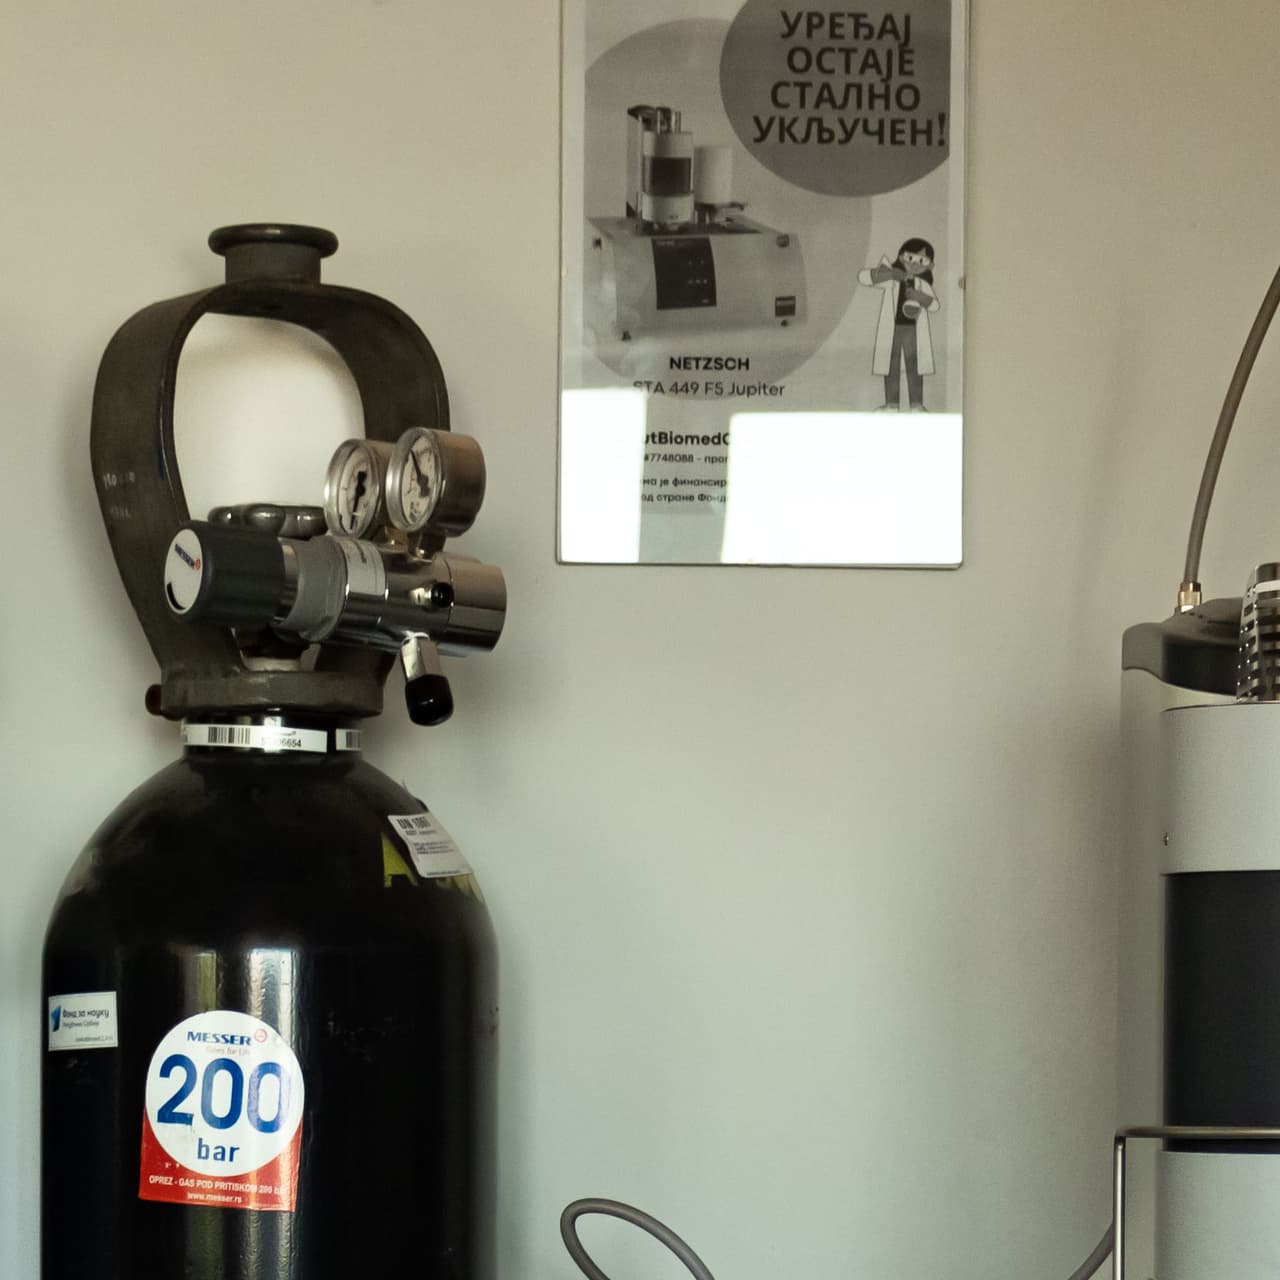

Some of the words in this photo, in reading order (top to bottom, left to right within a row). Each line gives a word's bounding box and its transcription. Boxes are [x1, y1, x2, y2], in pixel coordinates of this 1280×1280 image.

[780, 11, 911, 44] УРЕЂАЈ
[786, 46, 915, 82] ОСТАЈЕ
[770, 81, 920, 112] СТАЛНО
[752, 114, 946, 146] УКЉУЧЕН!
[669, 357, 750, 371] NETZSCH
[669, 381, 699, 395] 449
[704, 382, 725, 396] F5
[728, 382, 785, 398] Jupiter
[187, 1031, 252, 1046] MESSER
[157, 1054, 291, 1133] 200
[197, 1138, 240, 1162] bar
[149, 1175, 173, 1186] OPREZ
[179, 1178, 195, 1188] GAS
[196, 1179, 213, 1189] POD
[258, 1184, 272, 1194] 200
[187, 1192, 242, 1203] www.messer.rs
